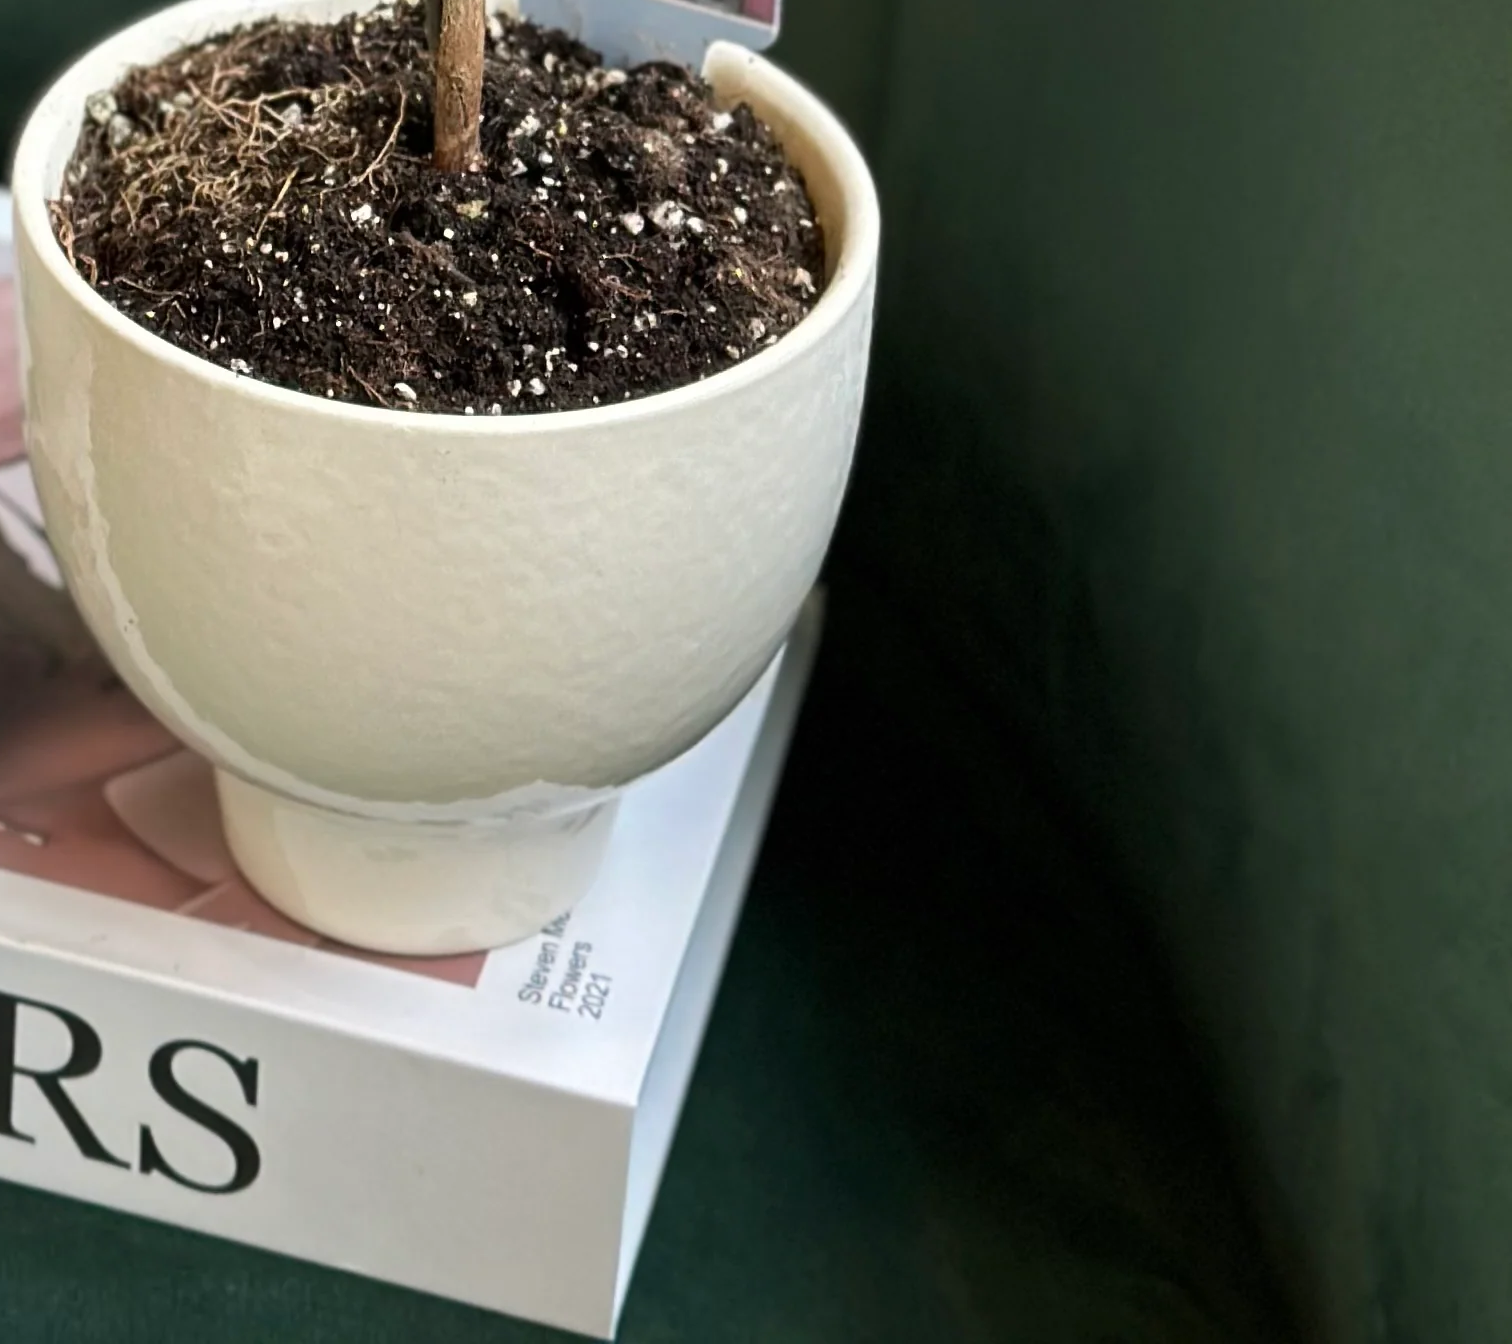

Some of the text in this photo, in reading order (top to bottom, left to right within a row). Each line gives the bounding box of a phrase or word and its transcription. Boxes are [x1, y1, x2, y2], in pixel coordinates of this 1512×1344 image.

[517, 941, 560, 1006] Steven
[547, 941, 593, 1013] Flowers
[577, 972, 613, 1021] 2021
